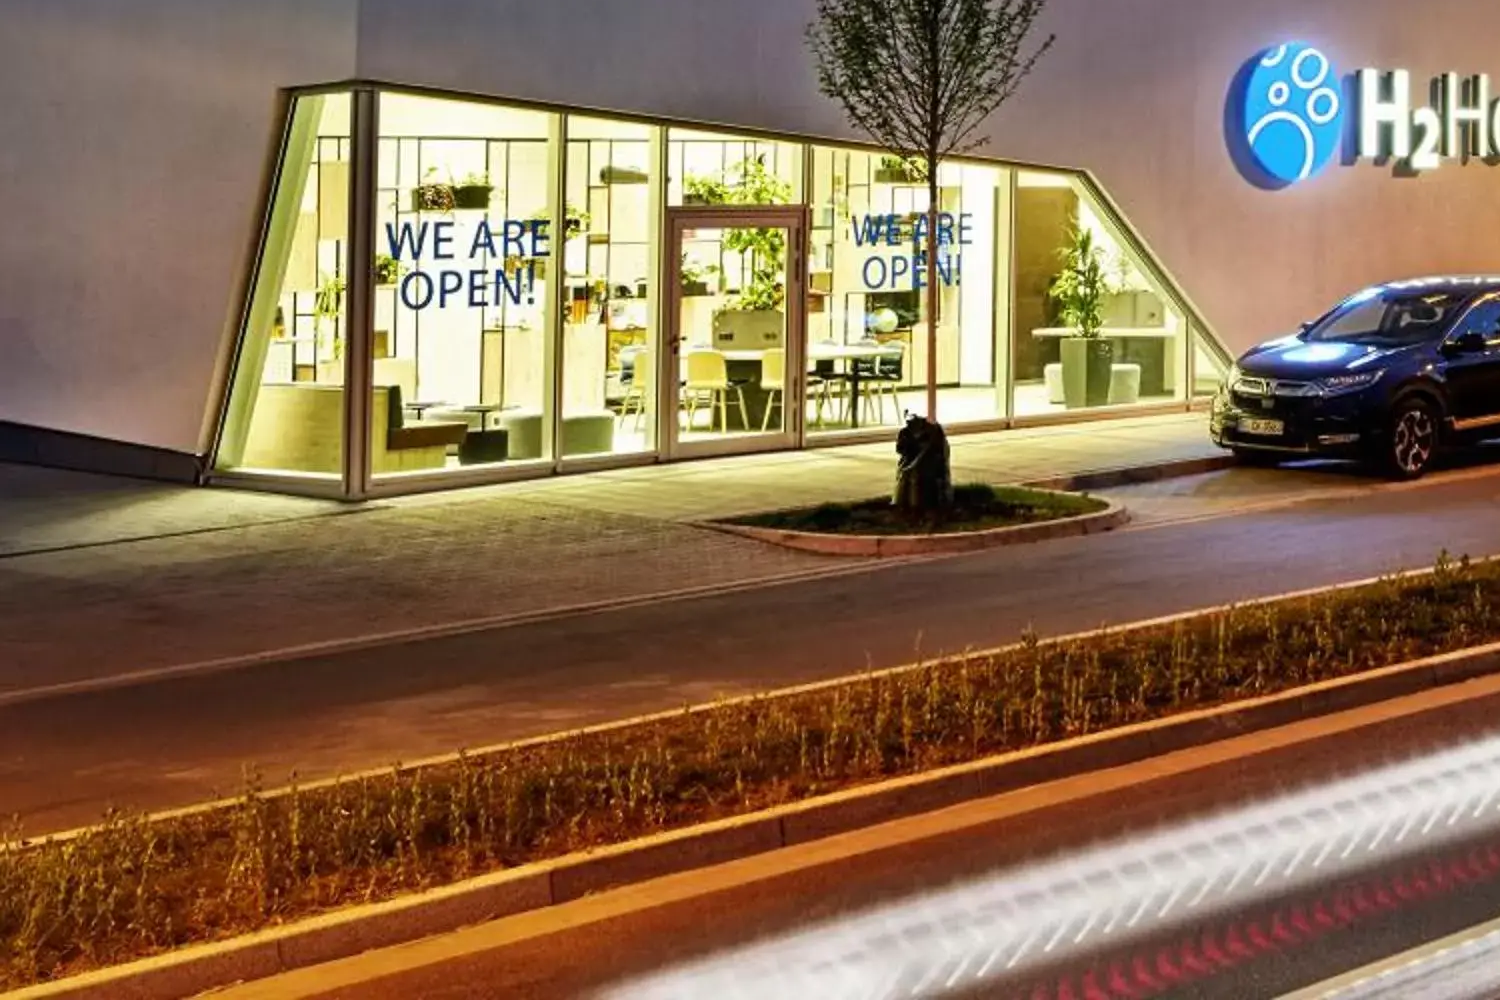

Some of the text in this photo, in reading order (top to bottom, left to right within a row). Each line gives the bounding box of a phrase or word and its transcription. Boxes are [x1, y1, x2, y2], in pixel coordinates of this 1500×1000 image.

[385, 219, 551, 260] WE ARE
[852, 211, 972, 247] WE ARE
[401, 261, 536, 310] OPEN!
[862, 253, 961, 289] OPEN!
